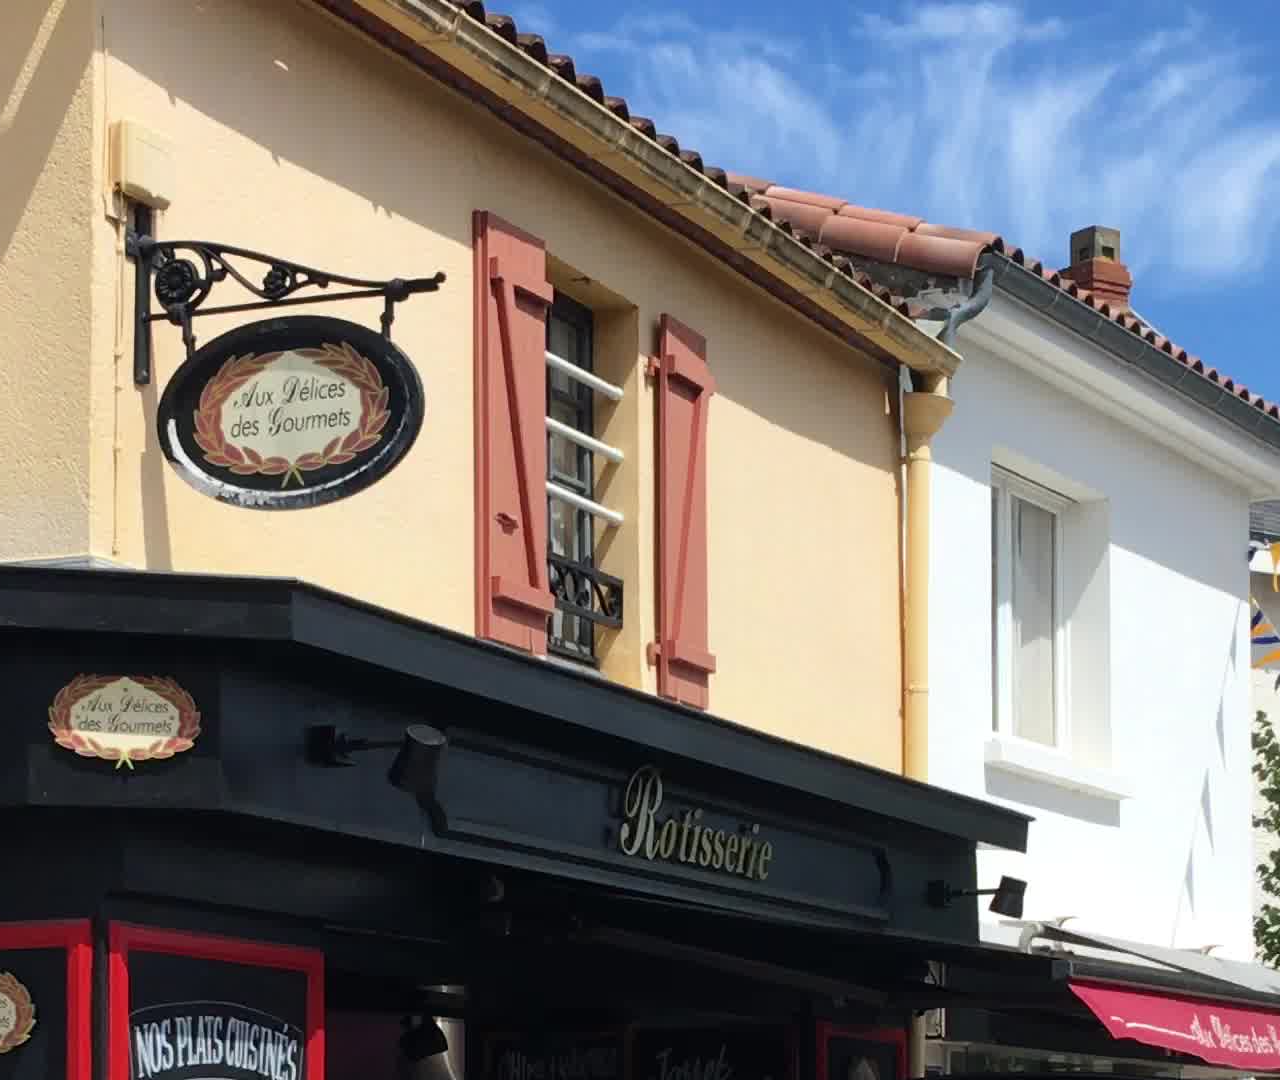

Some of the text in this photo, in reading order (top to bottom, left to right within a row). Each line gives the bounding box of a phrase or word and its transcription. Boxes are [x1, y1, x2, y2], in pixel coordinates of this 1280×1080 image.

[233, 375, 346, 408] Aux Délices
[230, 406, 351, 438] des Gourmets
[81, 695, 113, 712] Aux
[78, 713, 172, 733] des Gourmets
[620, 764, 772, 880] Rotisserie
[135, 1019, 174, 1079] NOS
[176, 1015, 224, 1068] PLATS
